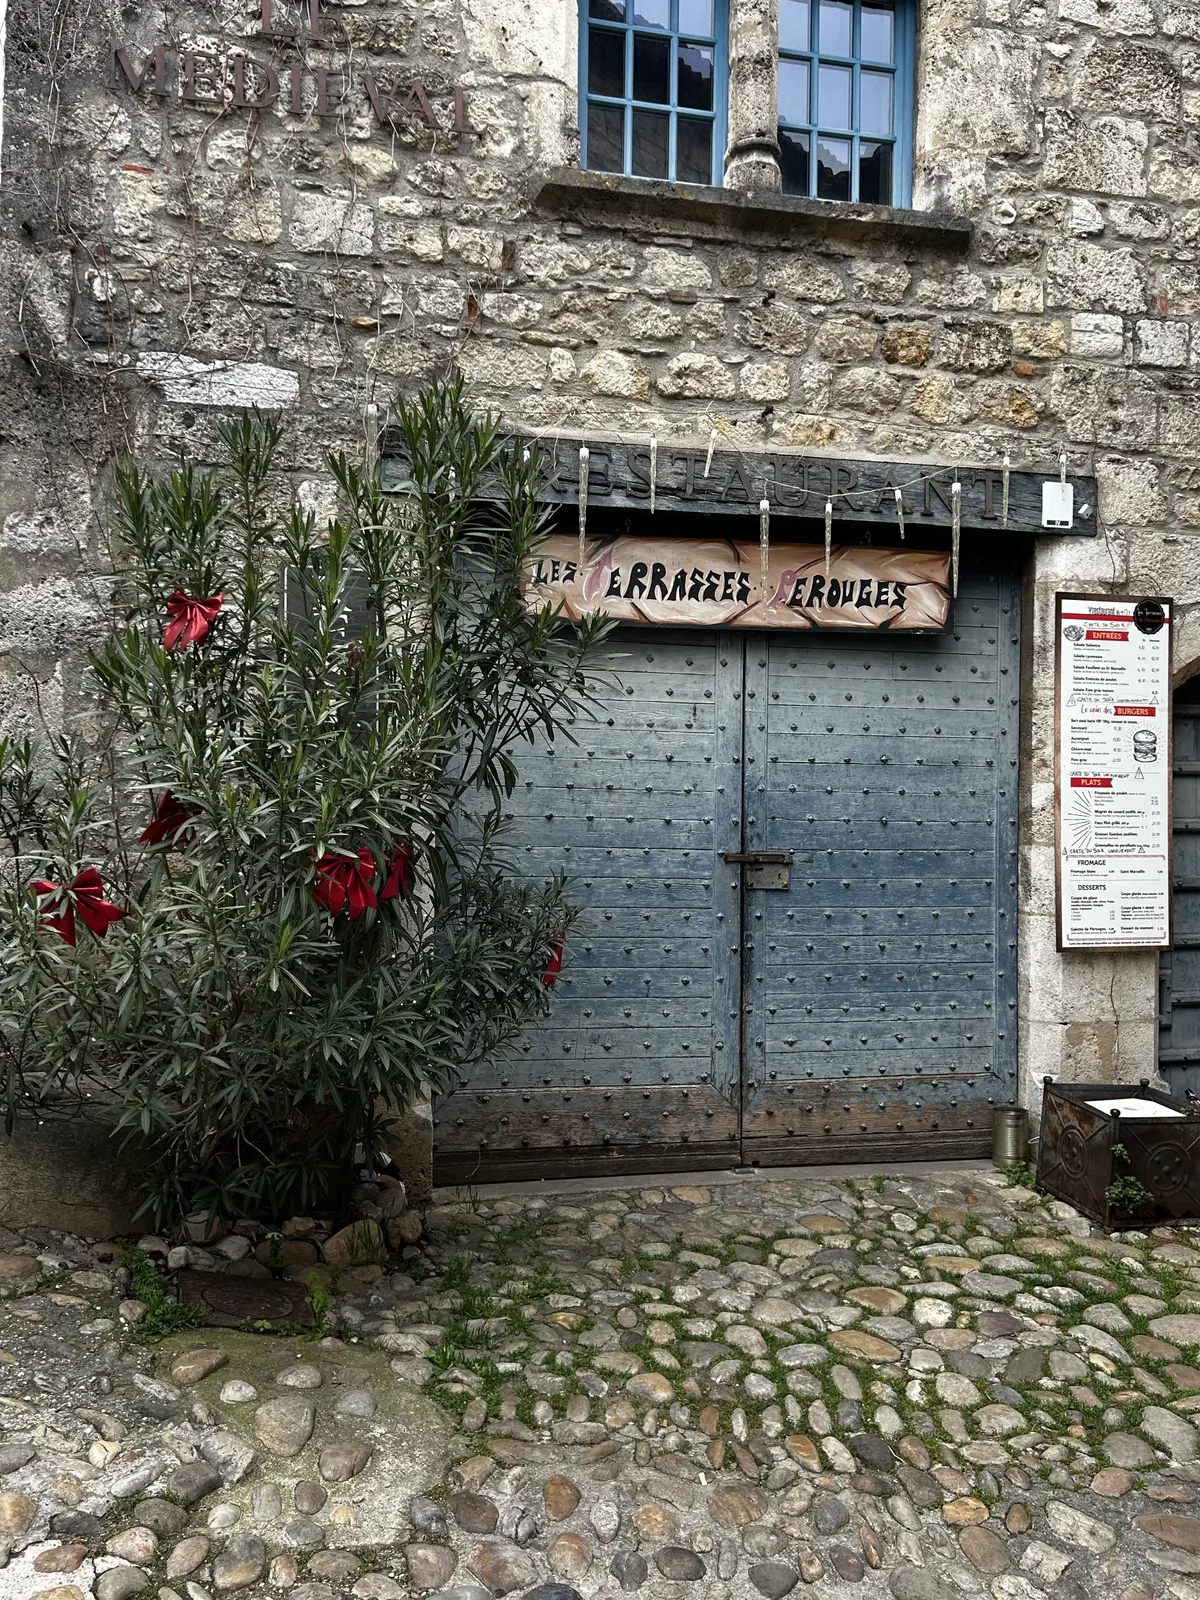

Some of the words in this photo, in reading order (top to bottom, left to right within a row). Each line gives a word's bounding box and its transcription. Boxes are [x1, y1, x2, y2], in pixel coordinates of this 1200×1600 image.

[106, 39, 487, 136] MEDIEVAL
[536, 559, 577, 585] LES
[584, 550, 752, 606] TERRASSES
[768, 569, 908, 611] PEROUGES
[1093, 632, 1122, 640] ENTRÉES
[1081, 704, 1088, 714] Le
[1103, 706, 1112, 714] des
